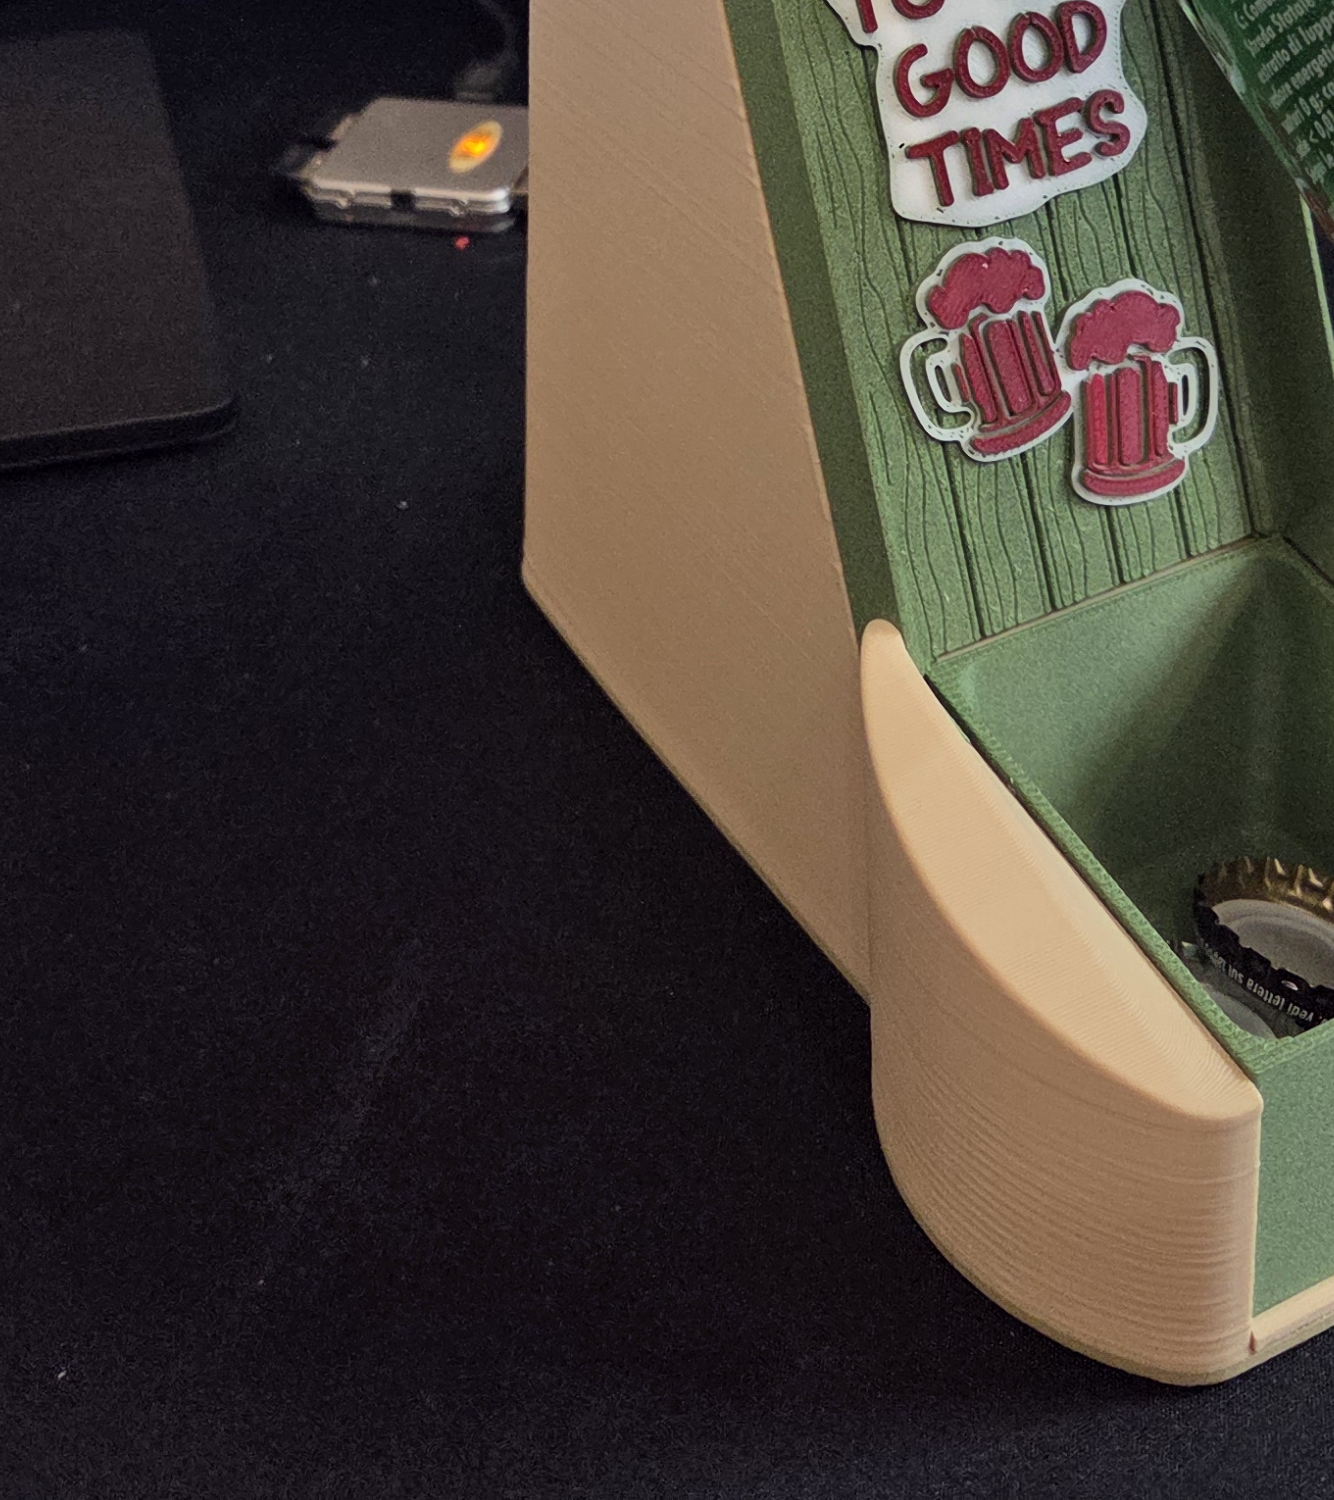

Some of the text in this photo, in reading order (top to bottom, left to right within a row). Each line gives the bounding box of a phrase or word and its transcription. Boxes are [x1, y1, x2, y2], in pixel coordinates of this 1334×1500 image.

[894, 0, 1108, 118] GOOD
[1282, 32, 1305, 56] di
[905, 88, 1132, 208] TIMES
[1222, 962, 1315, 1026] vedi lettera sul
